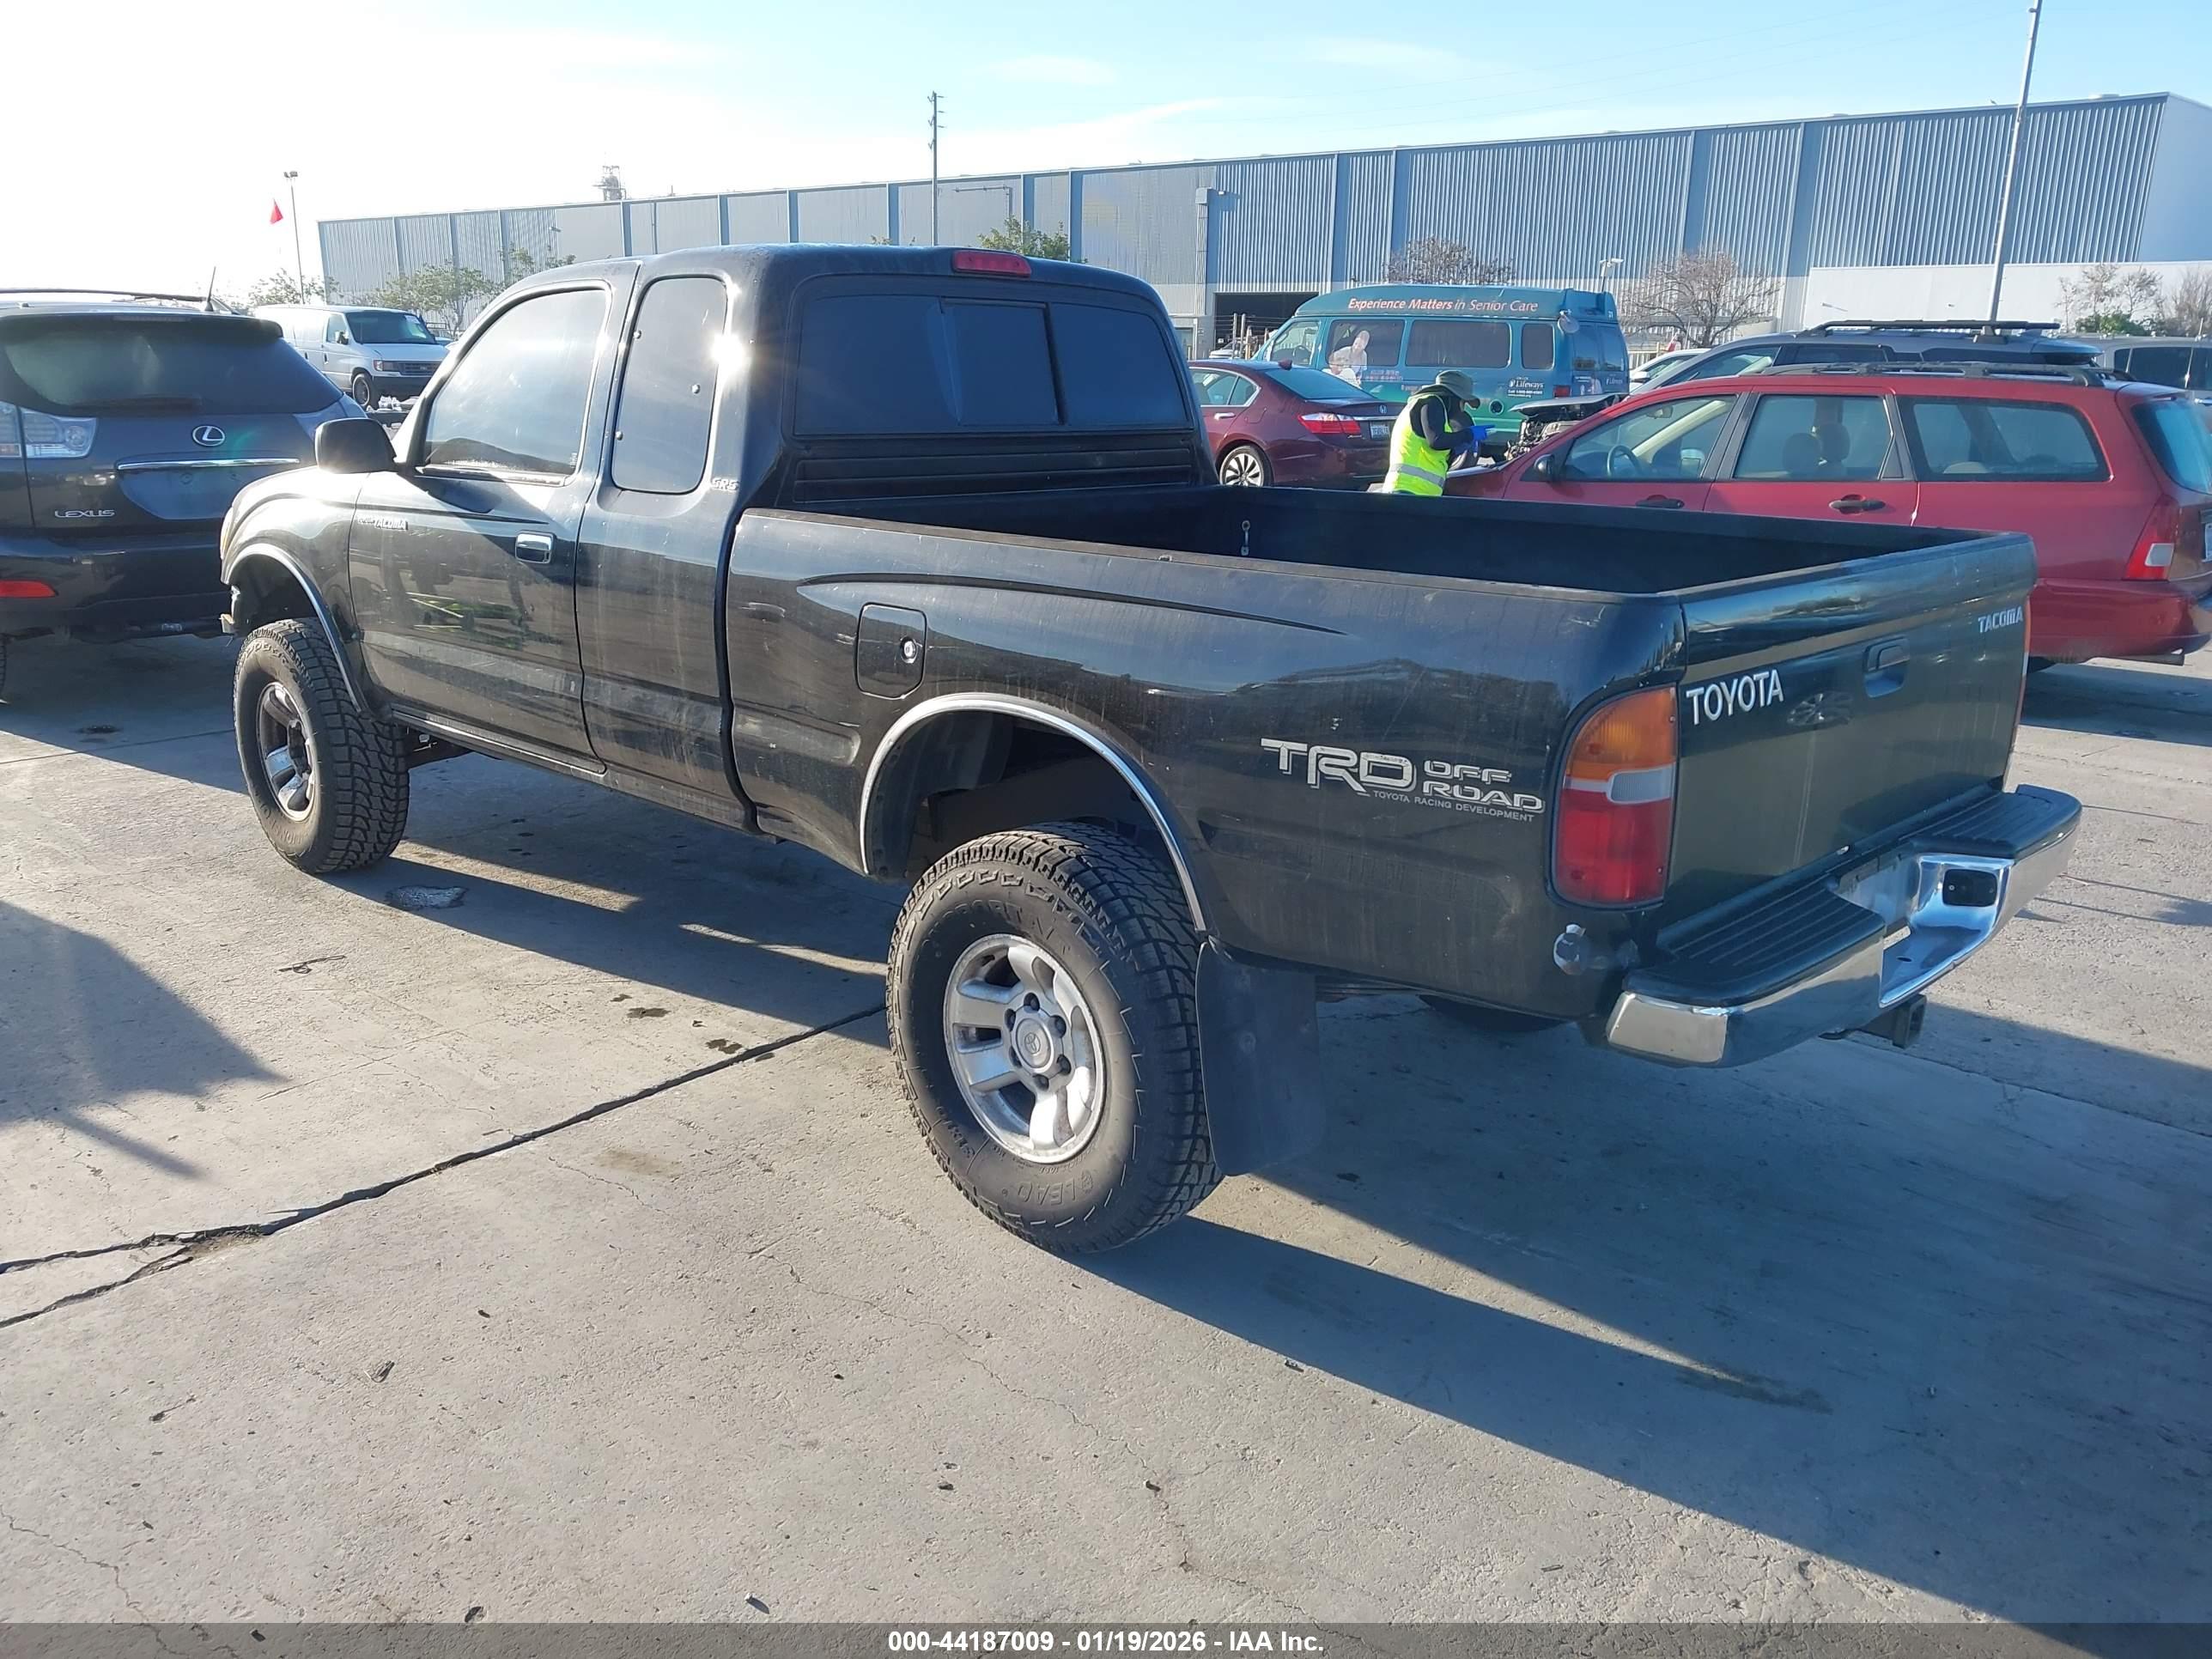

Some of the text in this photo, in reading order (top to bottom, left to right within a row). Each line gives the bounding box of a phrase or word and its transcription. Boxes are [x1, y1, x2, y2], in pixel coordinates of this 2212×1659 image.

[1348, 298, 1539, 312] Experience Matters in Senior Care
[55, 509, 115, 518] LEXUS
[1978, 605, 2023, 634] TACOMA
[1686, 669, 1784, 726] TOYOTA
[1261, 738, 1417, 797] TRD
[1423, 759, 1512, 785] OFF
[1374, 790, 1534, 822] TOYOTA RACING DEVELOPMENT
[1422, 781, 1546, 814] ROAD
